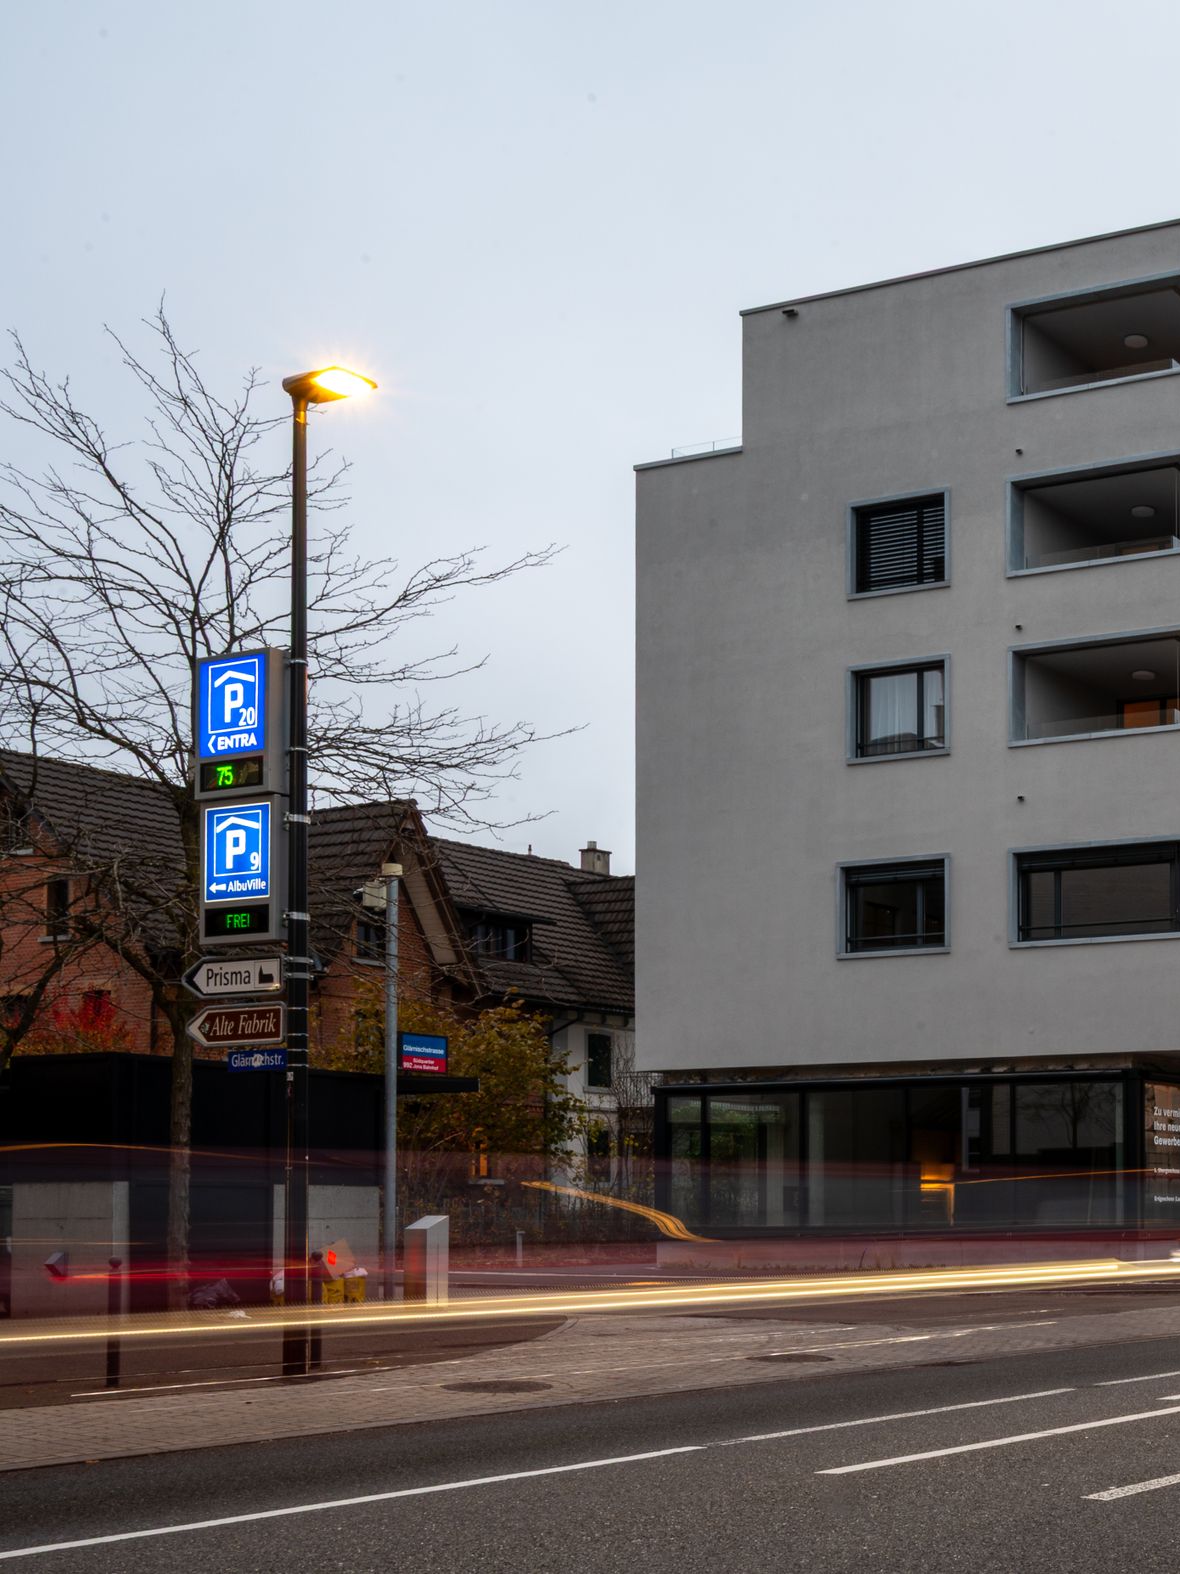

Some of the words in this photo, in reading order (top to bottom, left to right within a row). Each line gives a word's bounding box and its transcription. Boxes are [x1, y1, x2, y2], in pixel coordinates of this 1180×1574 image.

[224, 683, 244, 723] P
[238, 707, 255, 726] 20
[217, 732, 257, 750] ENTRA
[216, 765, 234, 786] 75
[225, 829, 246, 869] P
[250, 852, 260, 870] 9
[227, 878, 266, 892] AlbuVille
[226, 913, 250, 928] FREI
[206, 967, 251, 987] Prisma
[209, 1016, 234, 1036] Alte
[238, 1012, 277, 1034] Fabrik
[231, 1052, 284, 1068] Glärnchstr.
[1154, 1106, 1162, 1116] Zu
[1153, 1120, 1166, 1131] Ihre
